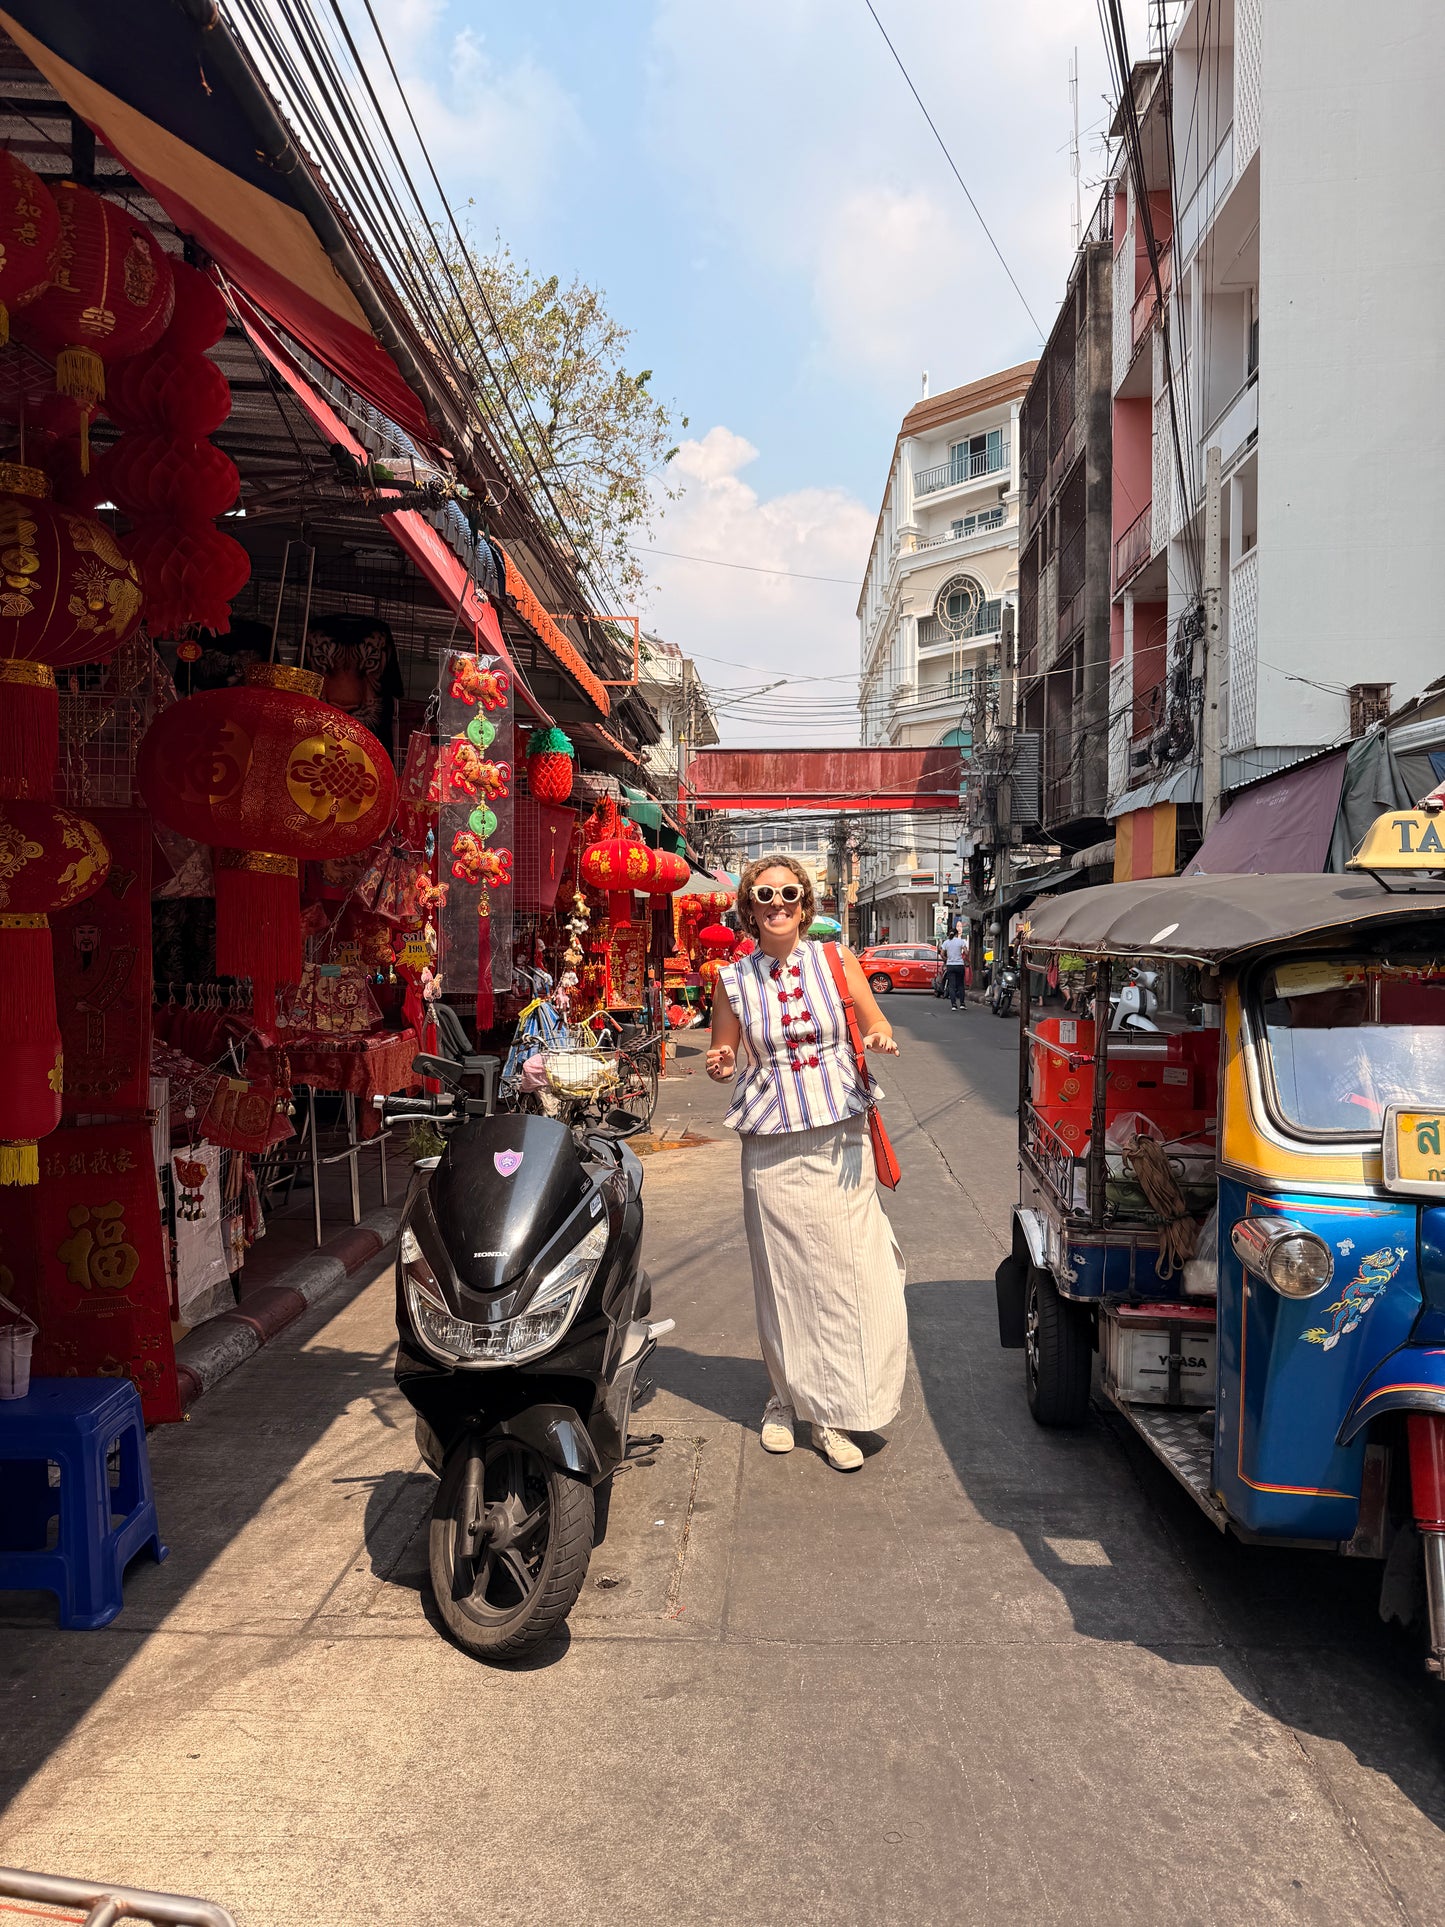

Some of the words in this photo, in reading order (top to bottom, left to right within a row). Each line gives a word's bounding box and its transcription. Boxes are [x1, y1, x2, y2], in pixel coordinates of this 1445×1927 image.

[1391, 819, 1445, 853] TA
[403, 930, 424, 941] sal
[339, 940, 359, 950] sal
[56, 1199, 140, 1290] 福
[1159, 1355, 1207, 1368] YASA
